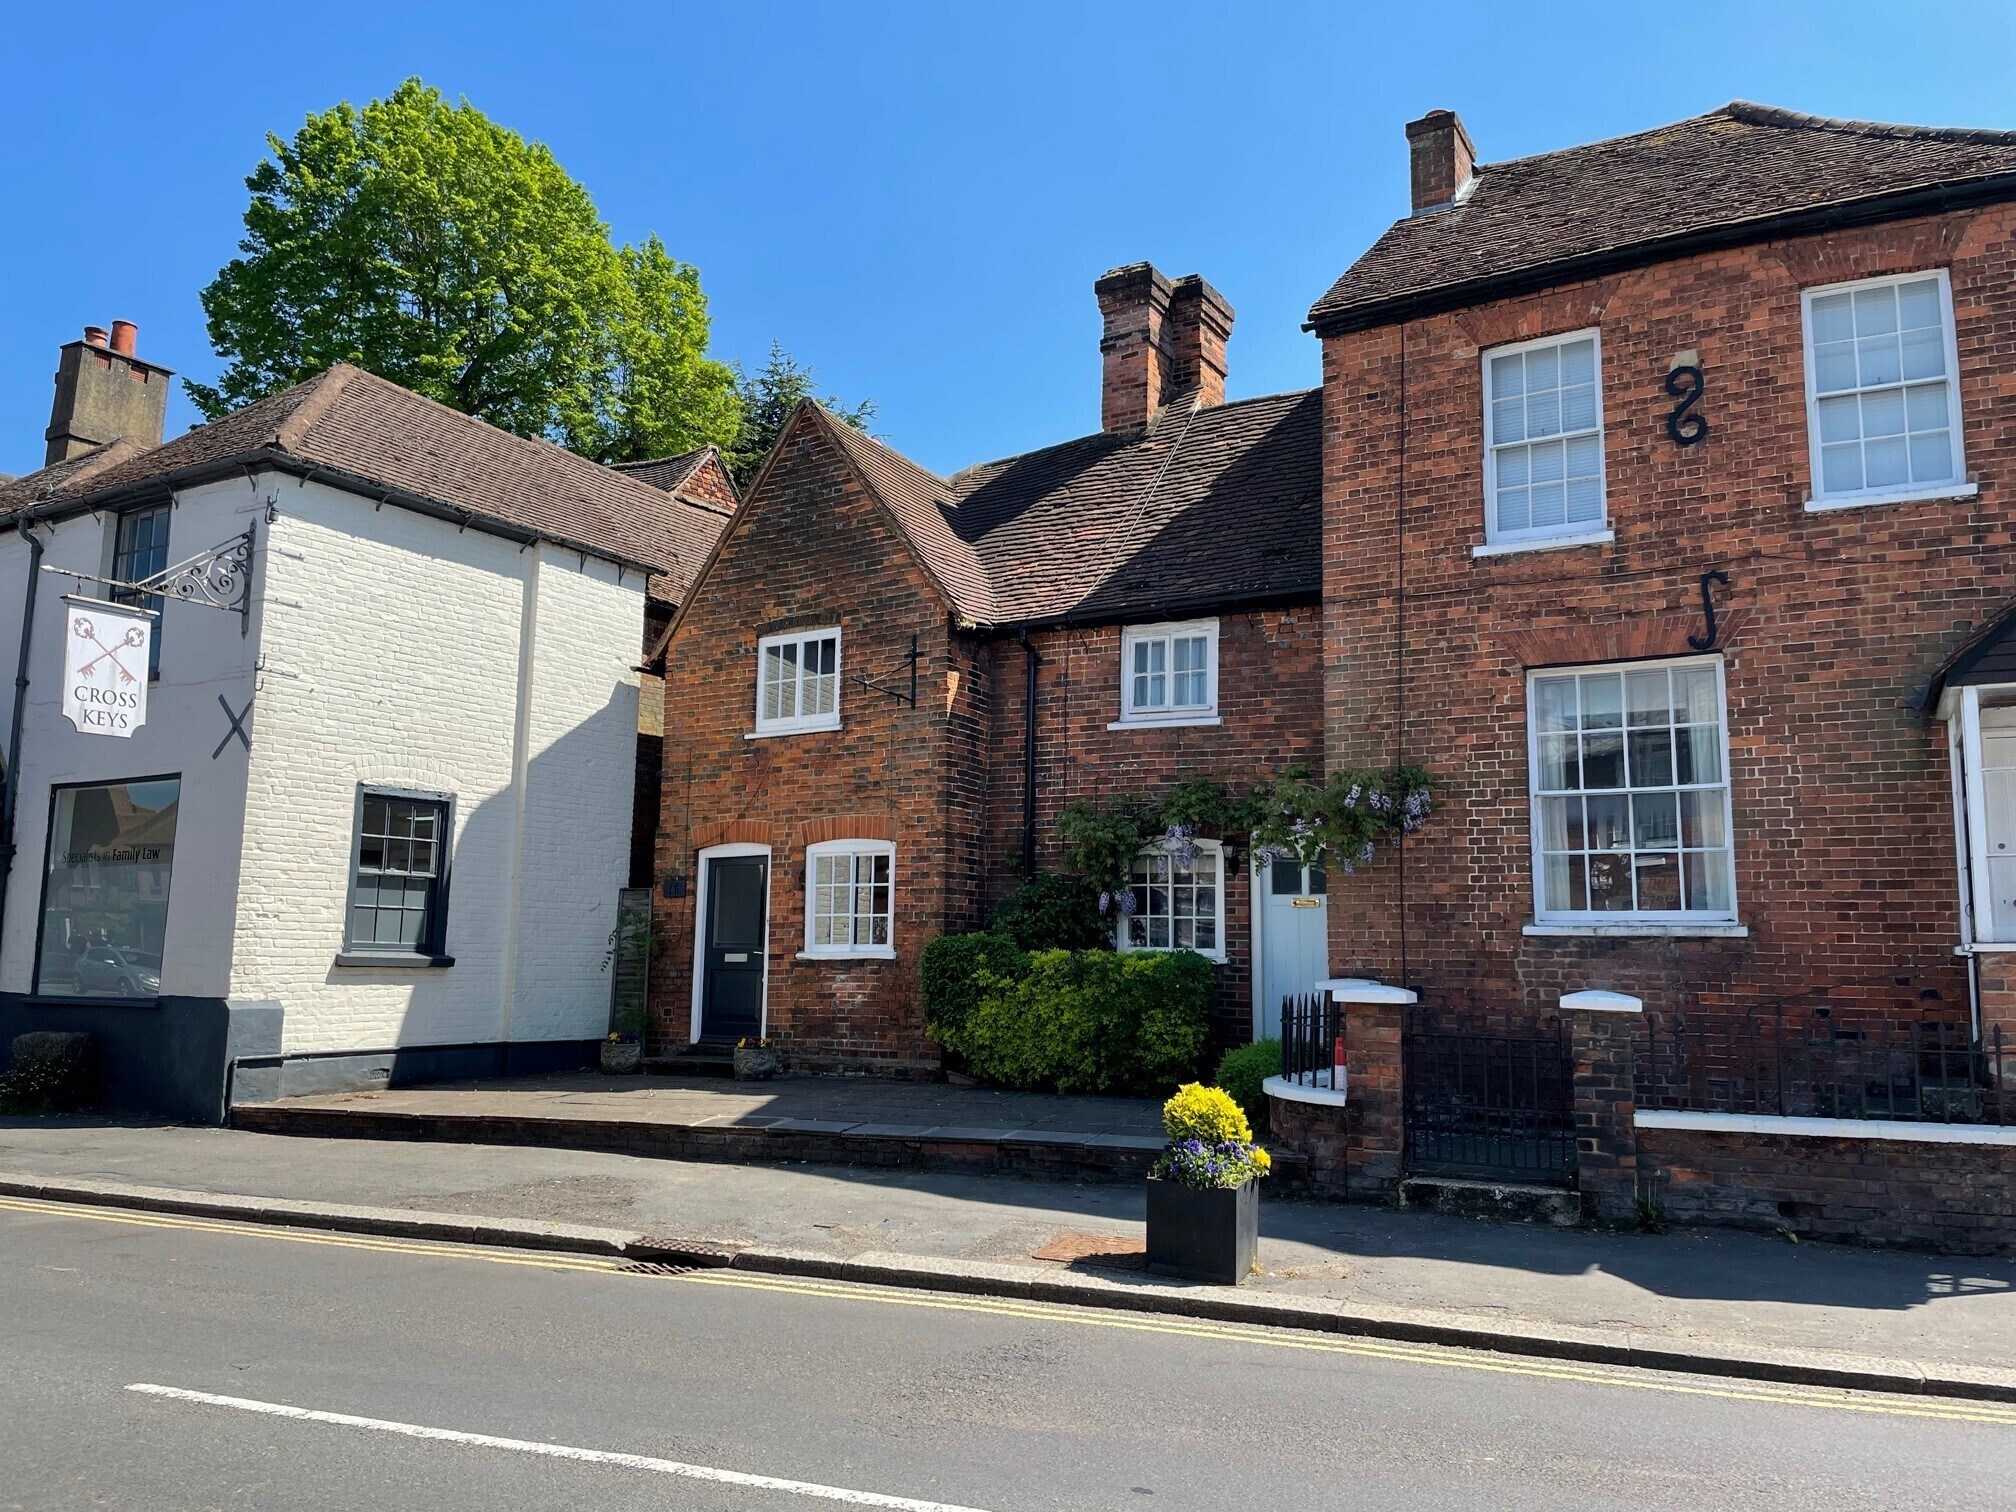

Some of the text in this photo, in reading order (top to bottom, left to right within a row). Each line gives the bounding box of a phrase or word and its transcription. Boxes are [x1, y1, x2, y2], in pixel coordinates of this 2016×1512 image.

[74, 685, 137, 708] CROSS
[82, 708, 128, 729] KEYS
[62, 846, 160, 864] Specialists in Family Law
